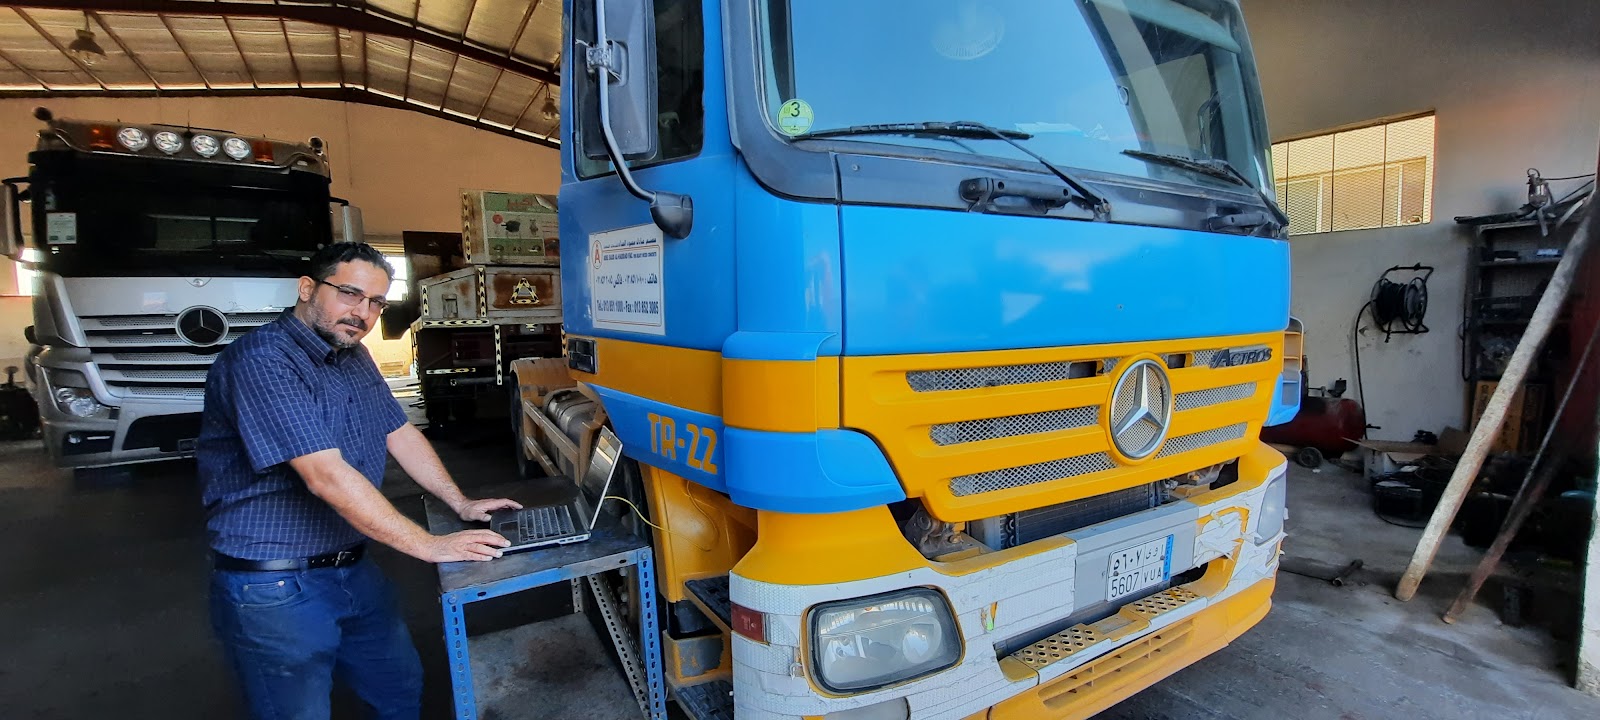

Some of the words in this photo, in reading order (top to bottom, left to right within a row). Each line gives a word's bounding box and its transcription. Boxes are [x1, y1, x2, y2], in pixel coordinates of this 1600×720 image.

[791, 102, 800, 117] 3
[648, 412, 718, 474] TR-22
[1112, 572, 1139, 598] 5607
[1144, 567, 1162, 583] VUA
